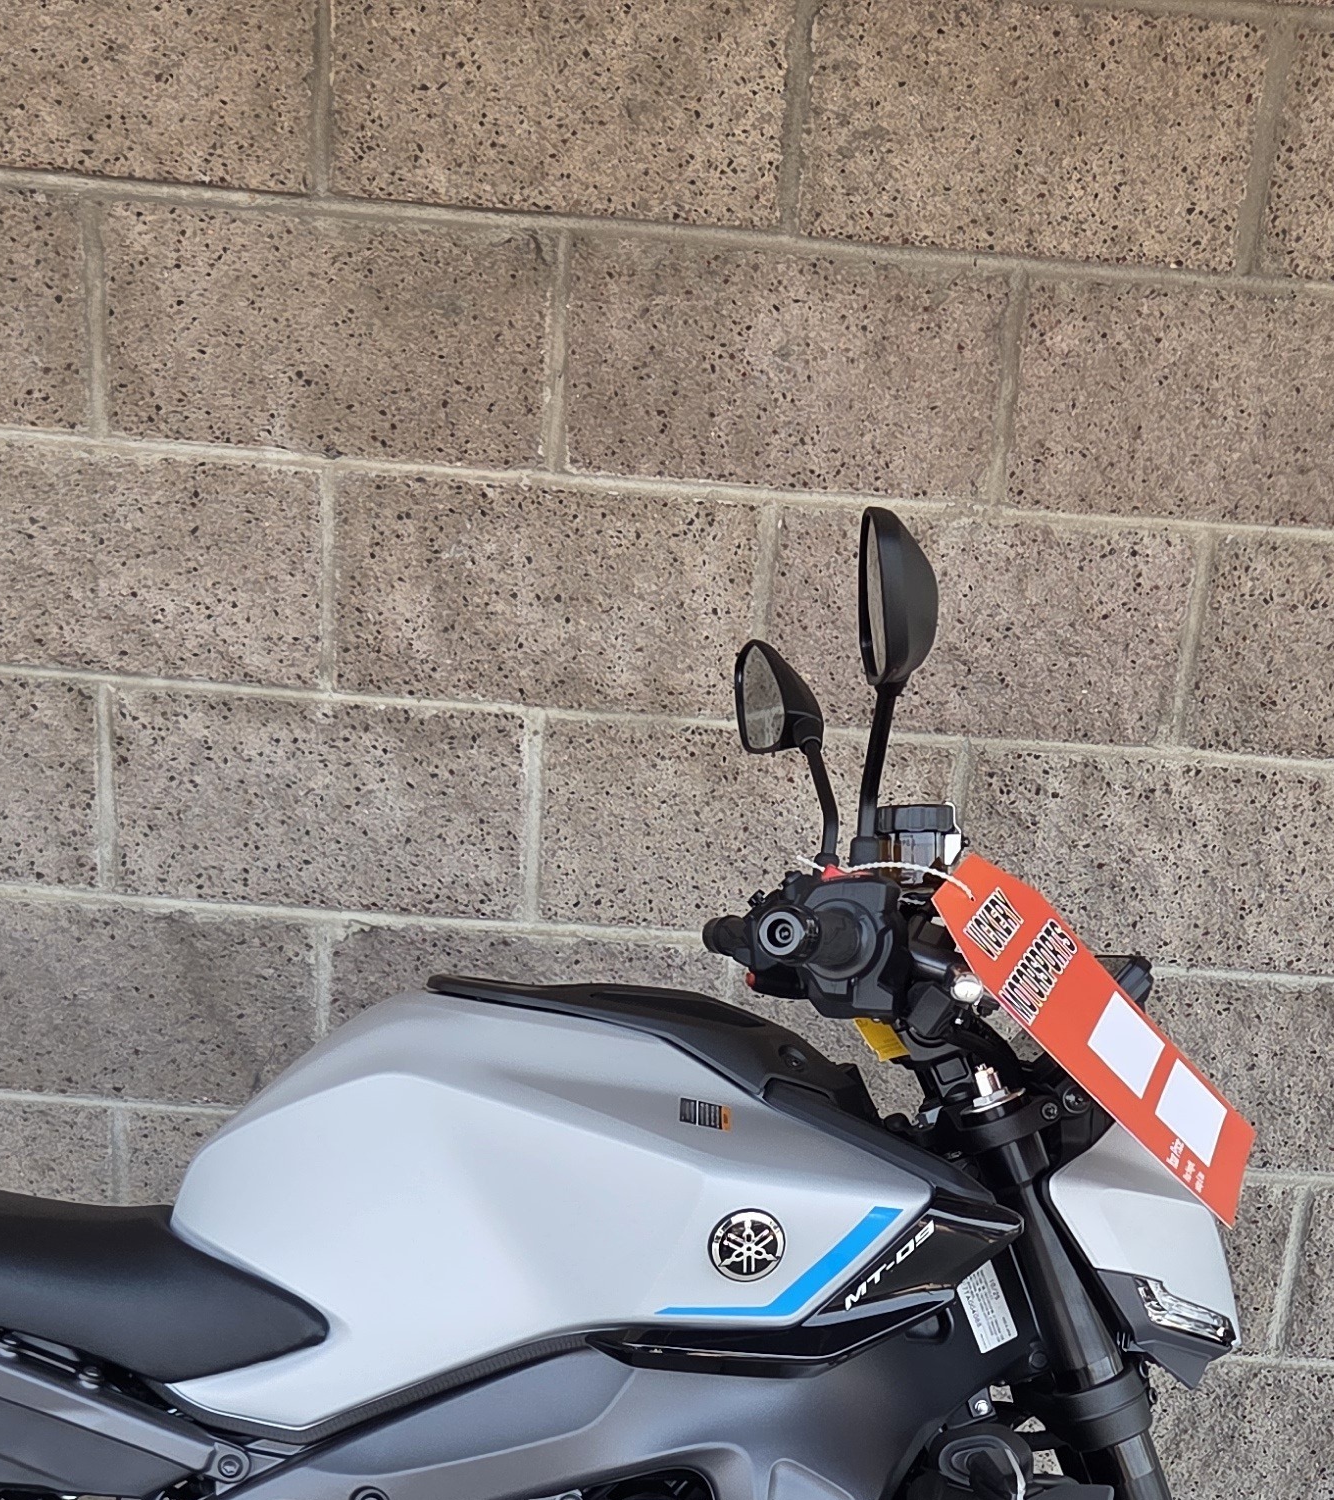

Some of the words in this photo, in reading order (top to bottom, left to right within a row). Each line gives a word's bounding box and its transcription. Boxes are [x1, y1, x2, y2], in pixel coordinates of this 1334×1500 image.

[963, 887, 1024, 961] VICKERY
[999, 918, 1077, 1026] MOTORSPORTS
[845, 1219, 935, 1311] MT-09
